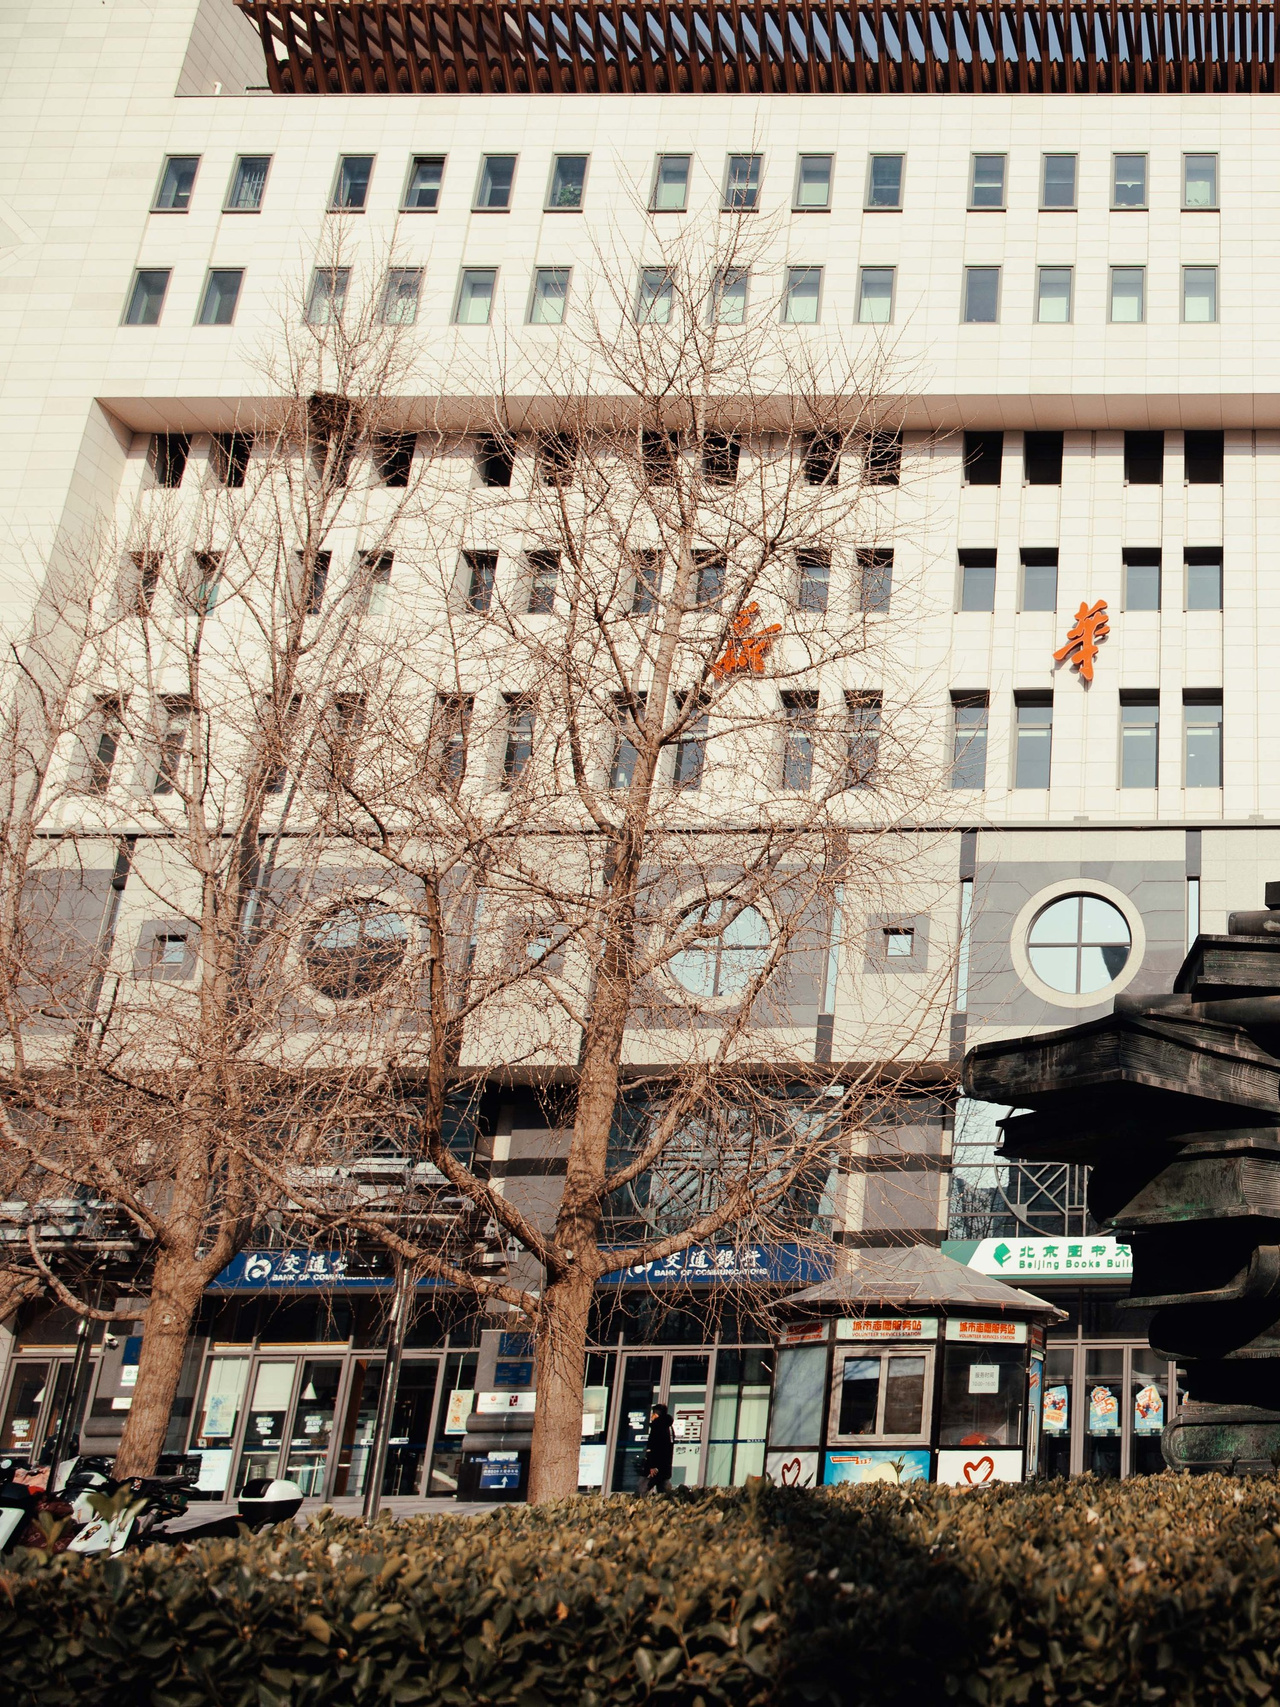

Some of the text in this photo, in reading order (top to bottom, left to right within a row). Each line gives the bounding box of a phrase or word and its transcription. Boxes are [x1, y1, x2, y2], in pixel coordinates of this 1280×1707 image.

[1019, 1244, 1131, 1258] 北京图书大
[1019, 1259, 1060, 1271] Beijing
[1066, 1259, 1101, 1269] Books
[272, 1273, 295, 1281] BANK
[299, 1273, 310, 1281] OF
[654, 1269, 677, 1277] BANK
[681, 1269, 693, 1277] OF
